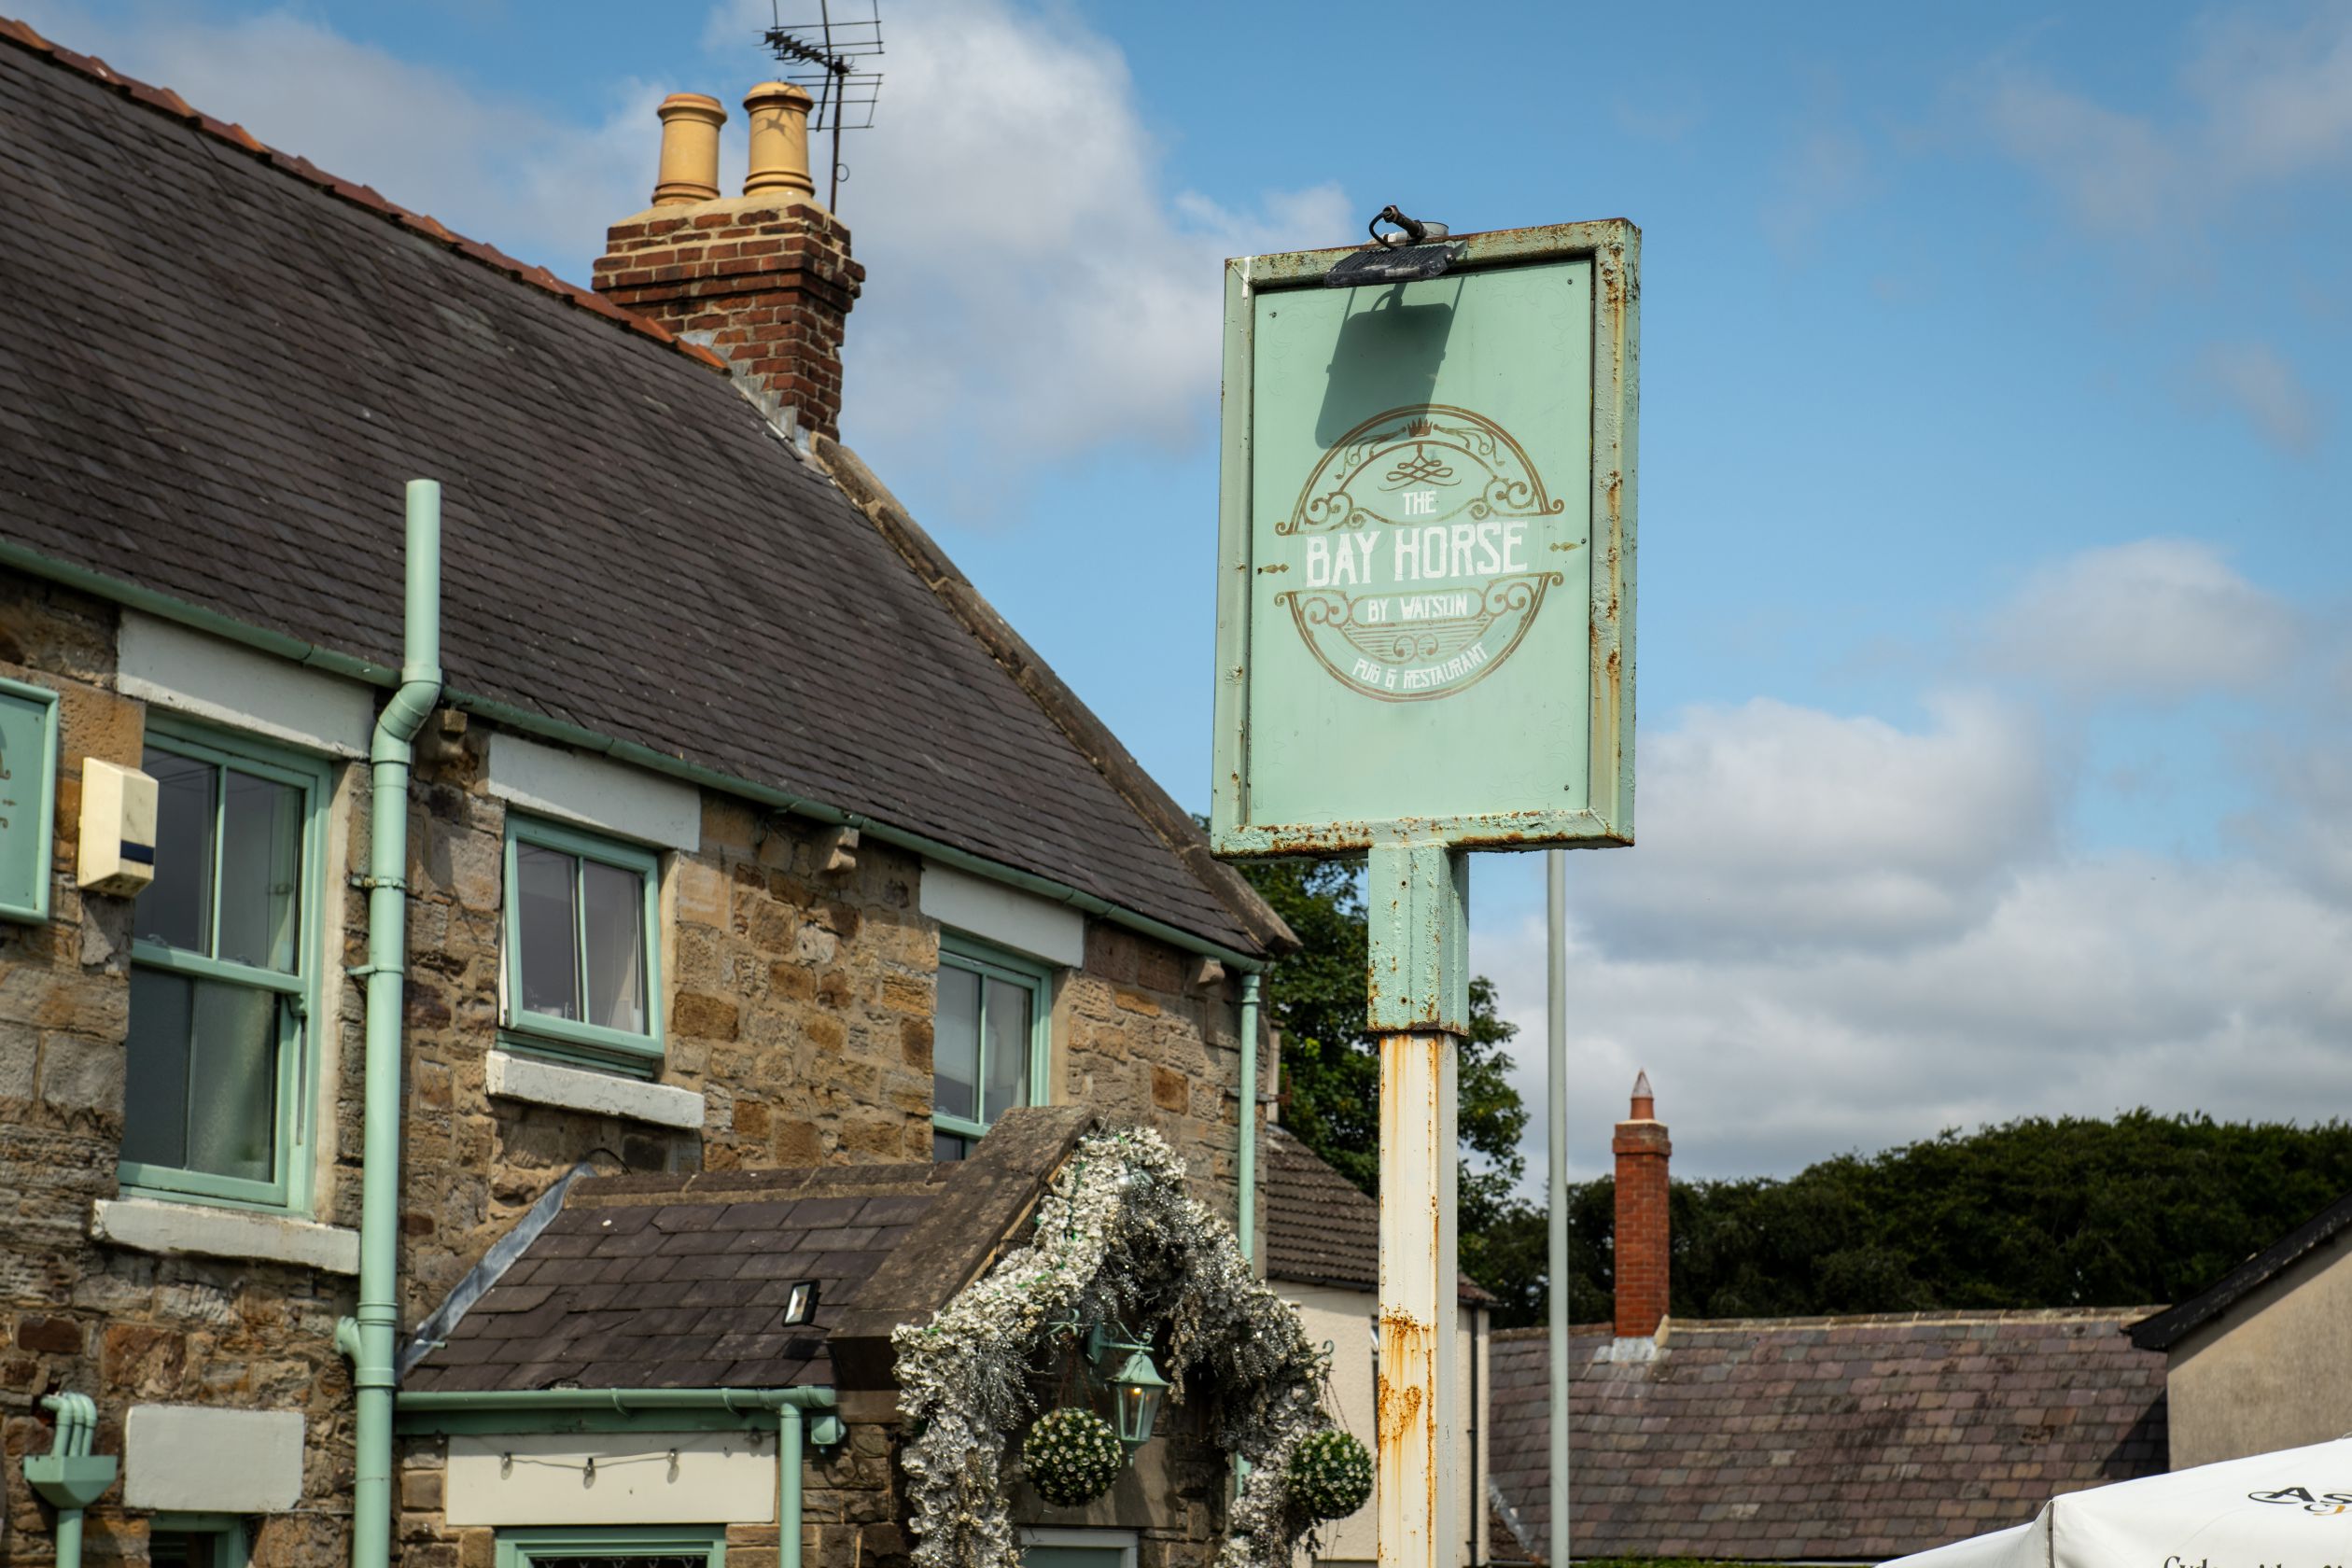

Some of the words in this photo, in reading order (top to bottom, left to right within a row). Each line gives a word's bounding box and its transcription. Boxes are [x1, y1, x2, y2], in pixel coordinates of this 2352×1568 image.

[1403, 491, 1436, 515] THE
[1306, 530, 1380, 588] BAY
[1394, 521, 1528, 581] HORSE
[1367, 598, 1389, 623] BY
[1400, 594, 1467, 620] WATSON
[1352, 657, 1380, 684] PUB
[1403, 642, 1489, 689] RESTAURANT
